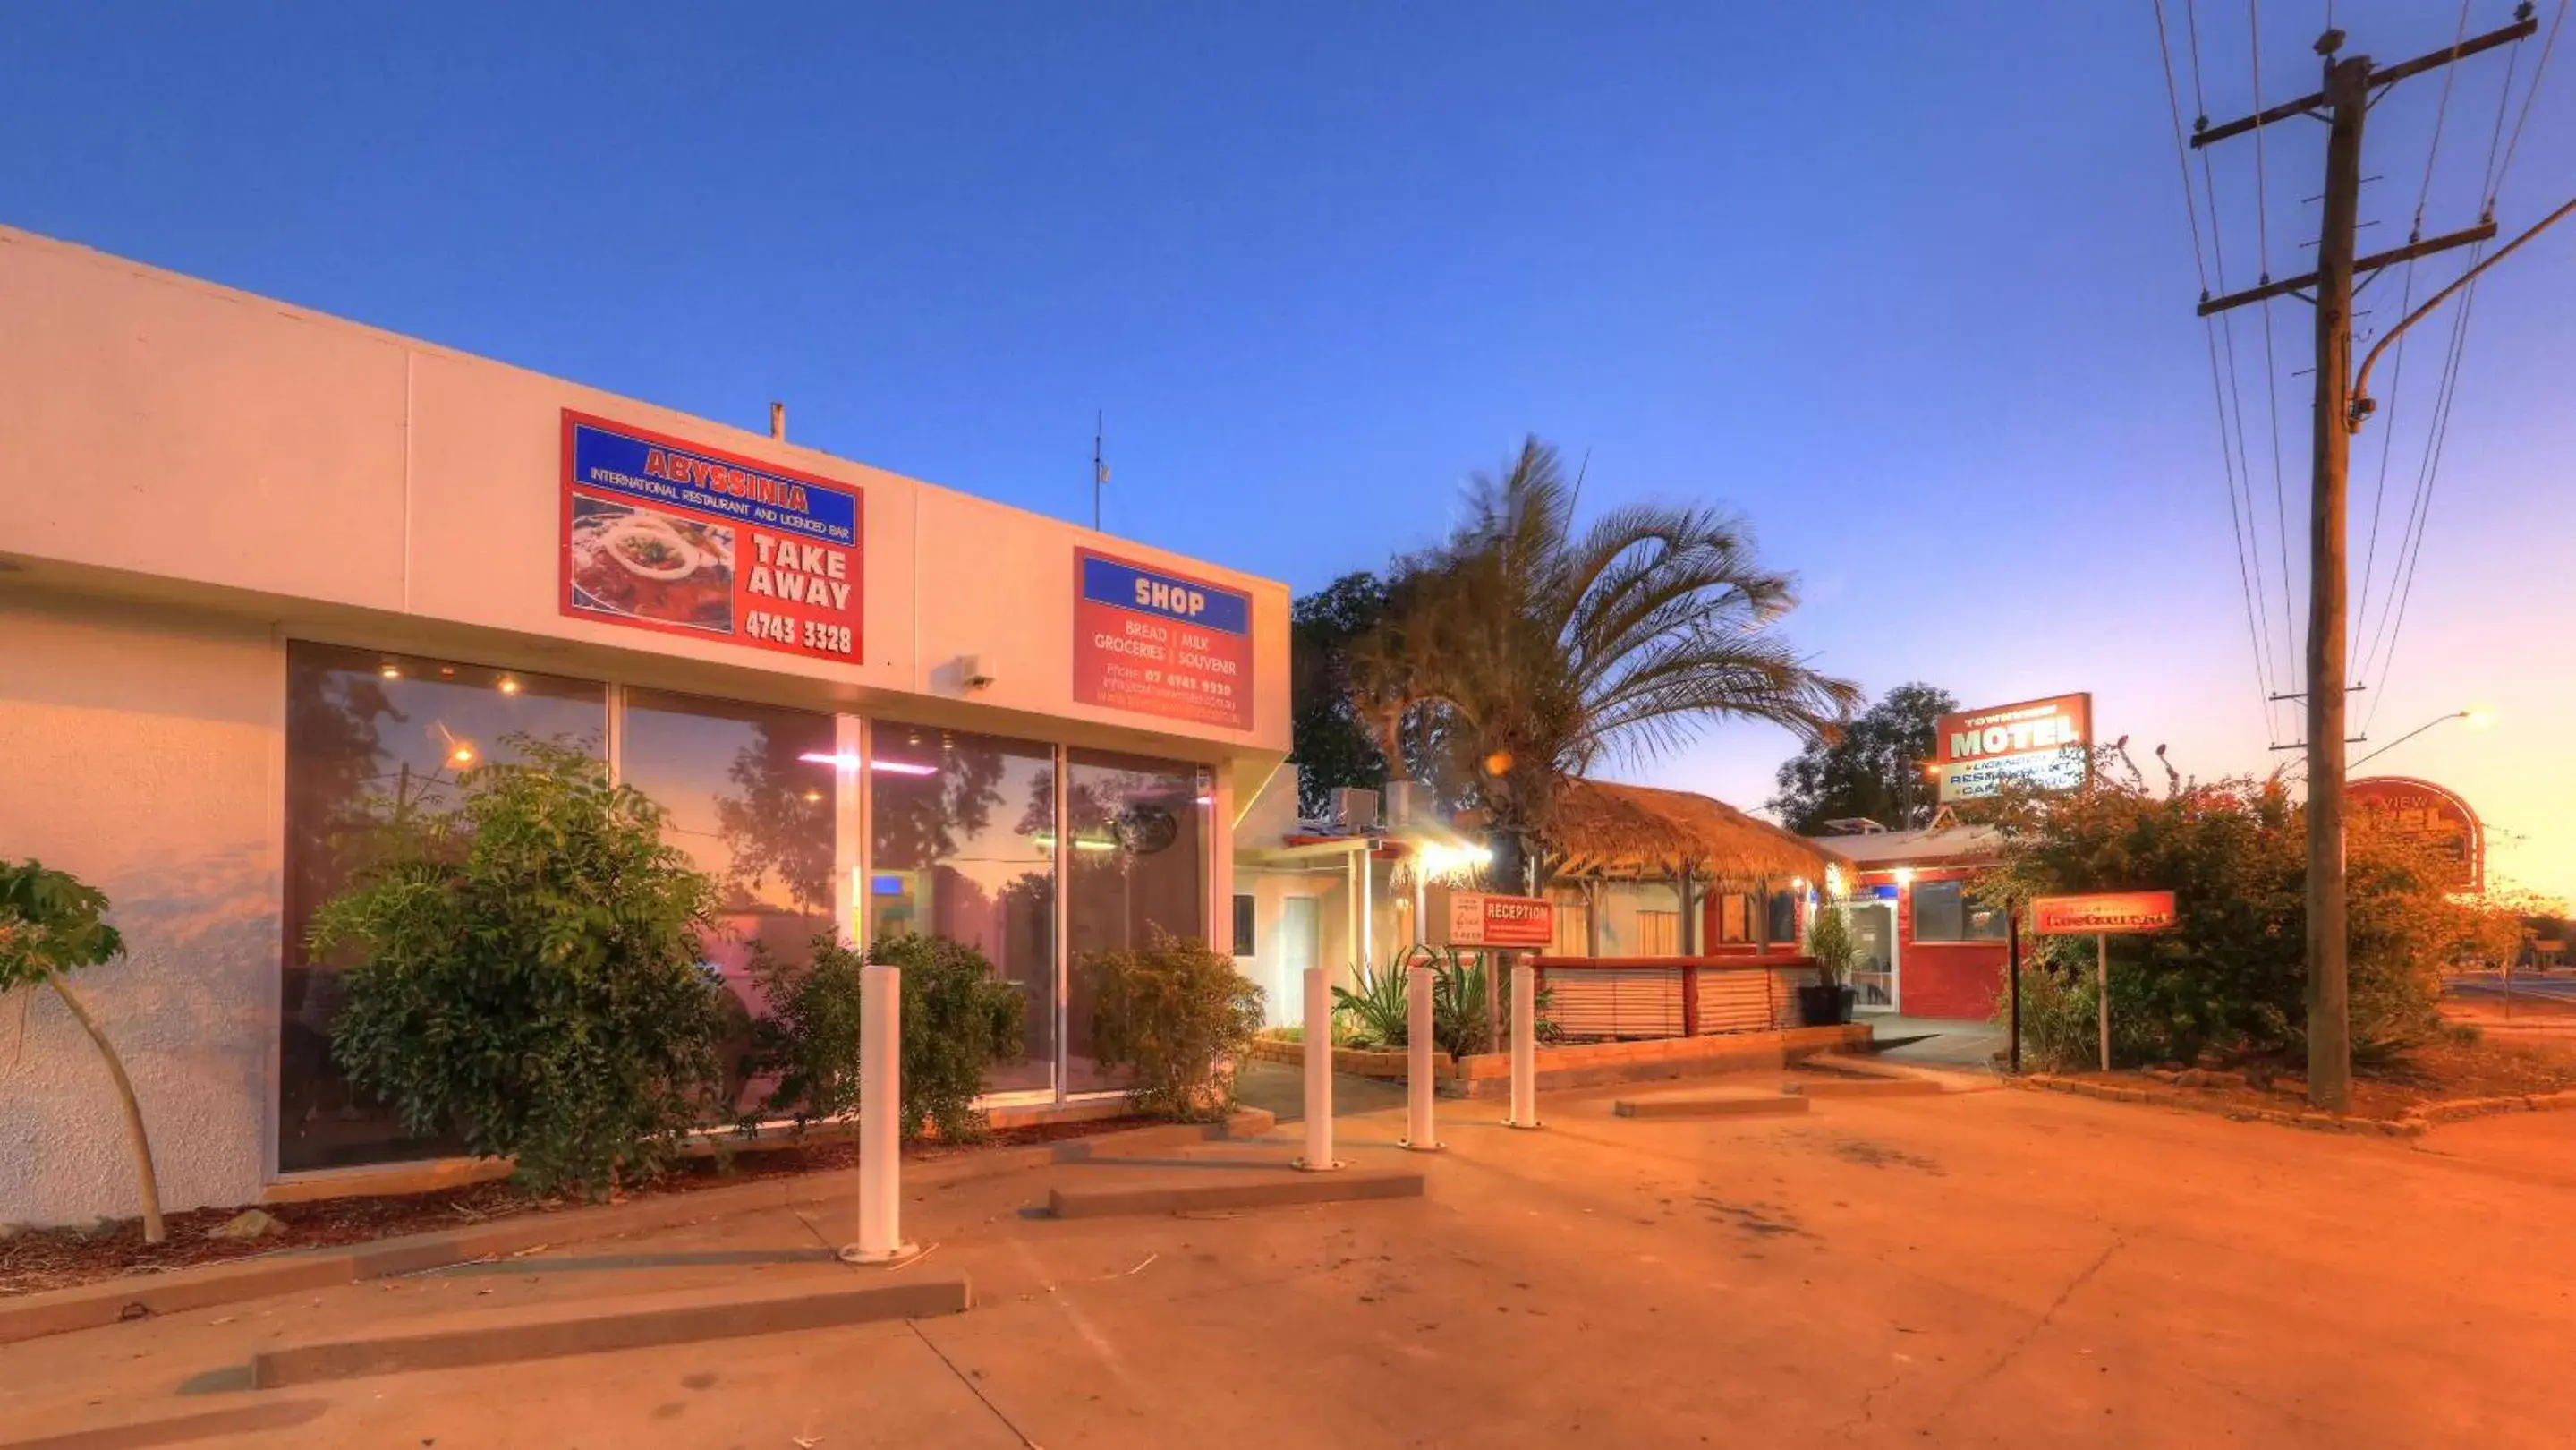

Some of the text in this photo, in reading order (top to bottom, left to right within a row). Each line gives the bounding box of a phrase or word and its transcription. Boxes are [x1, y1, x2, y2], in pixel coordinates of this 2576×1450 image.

[590, 466, 680, 500] INTERNATIONAL
[682, 489, 752, 516] RESTAURANT
[754, 507, 778, 522] AND
[829, 525, 849, 539] BAR
[643, 448, 809, 514] ABYSSINIA
[752, 533, 846, 580] TAKE
[747, 566, 851, 610] AWAY
[1135, 577, 1205, 617] SHOP
[746, 609, 851, 654] 4743 3328
[1126, 620, 1210, 651] BREAD MILK
[1094, 634, 1237, 676] GROCERIES SOUVENIR
[1951, 715, 2079, 759] MOTEL
[1488, 902, 1549, 920] RECEPTION
